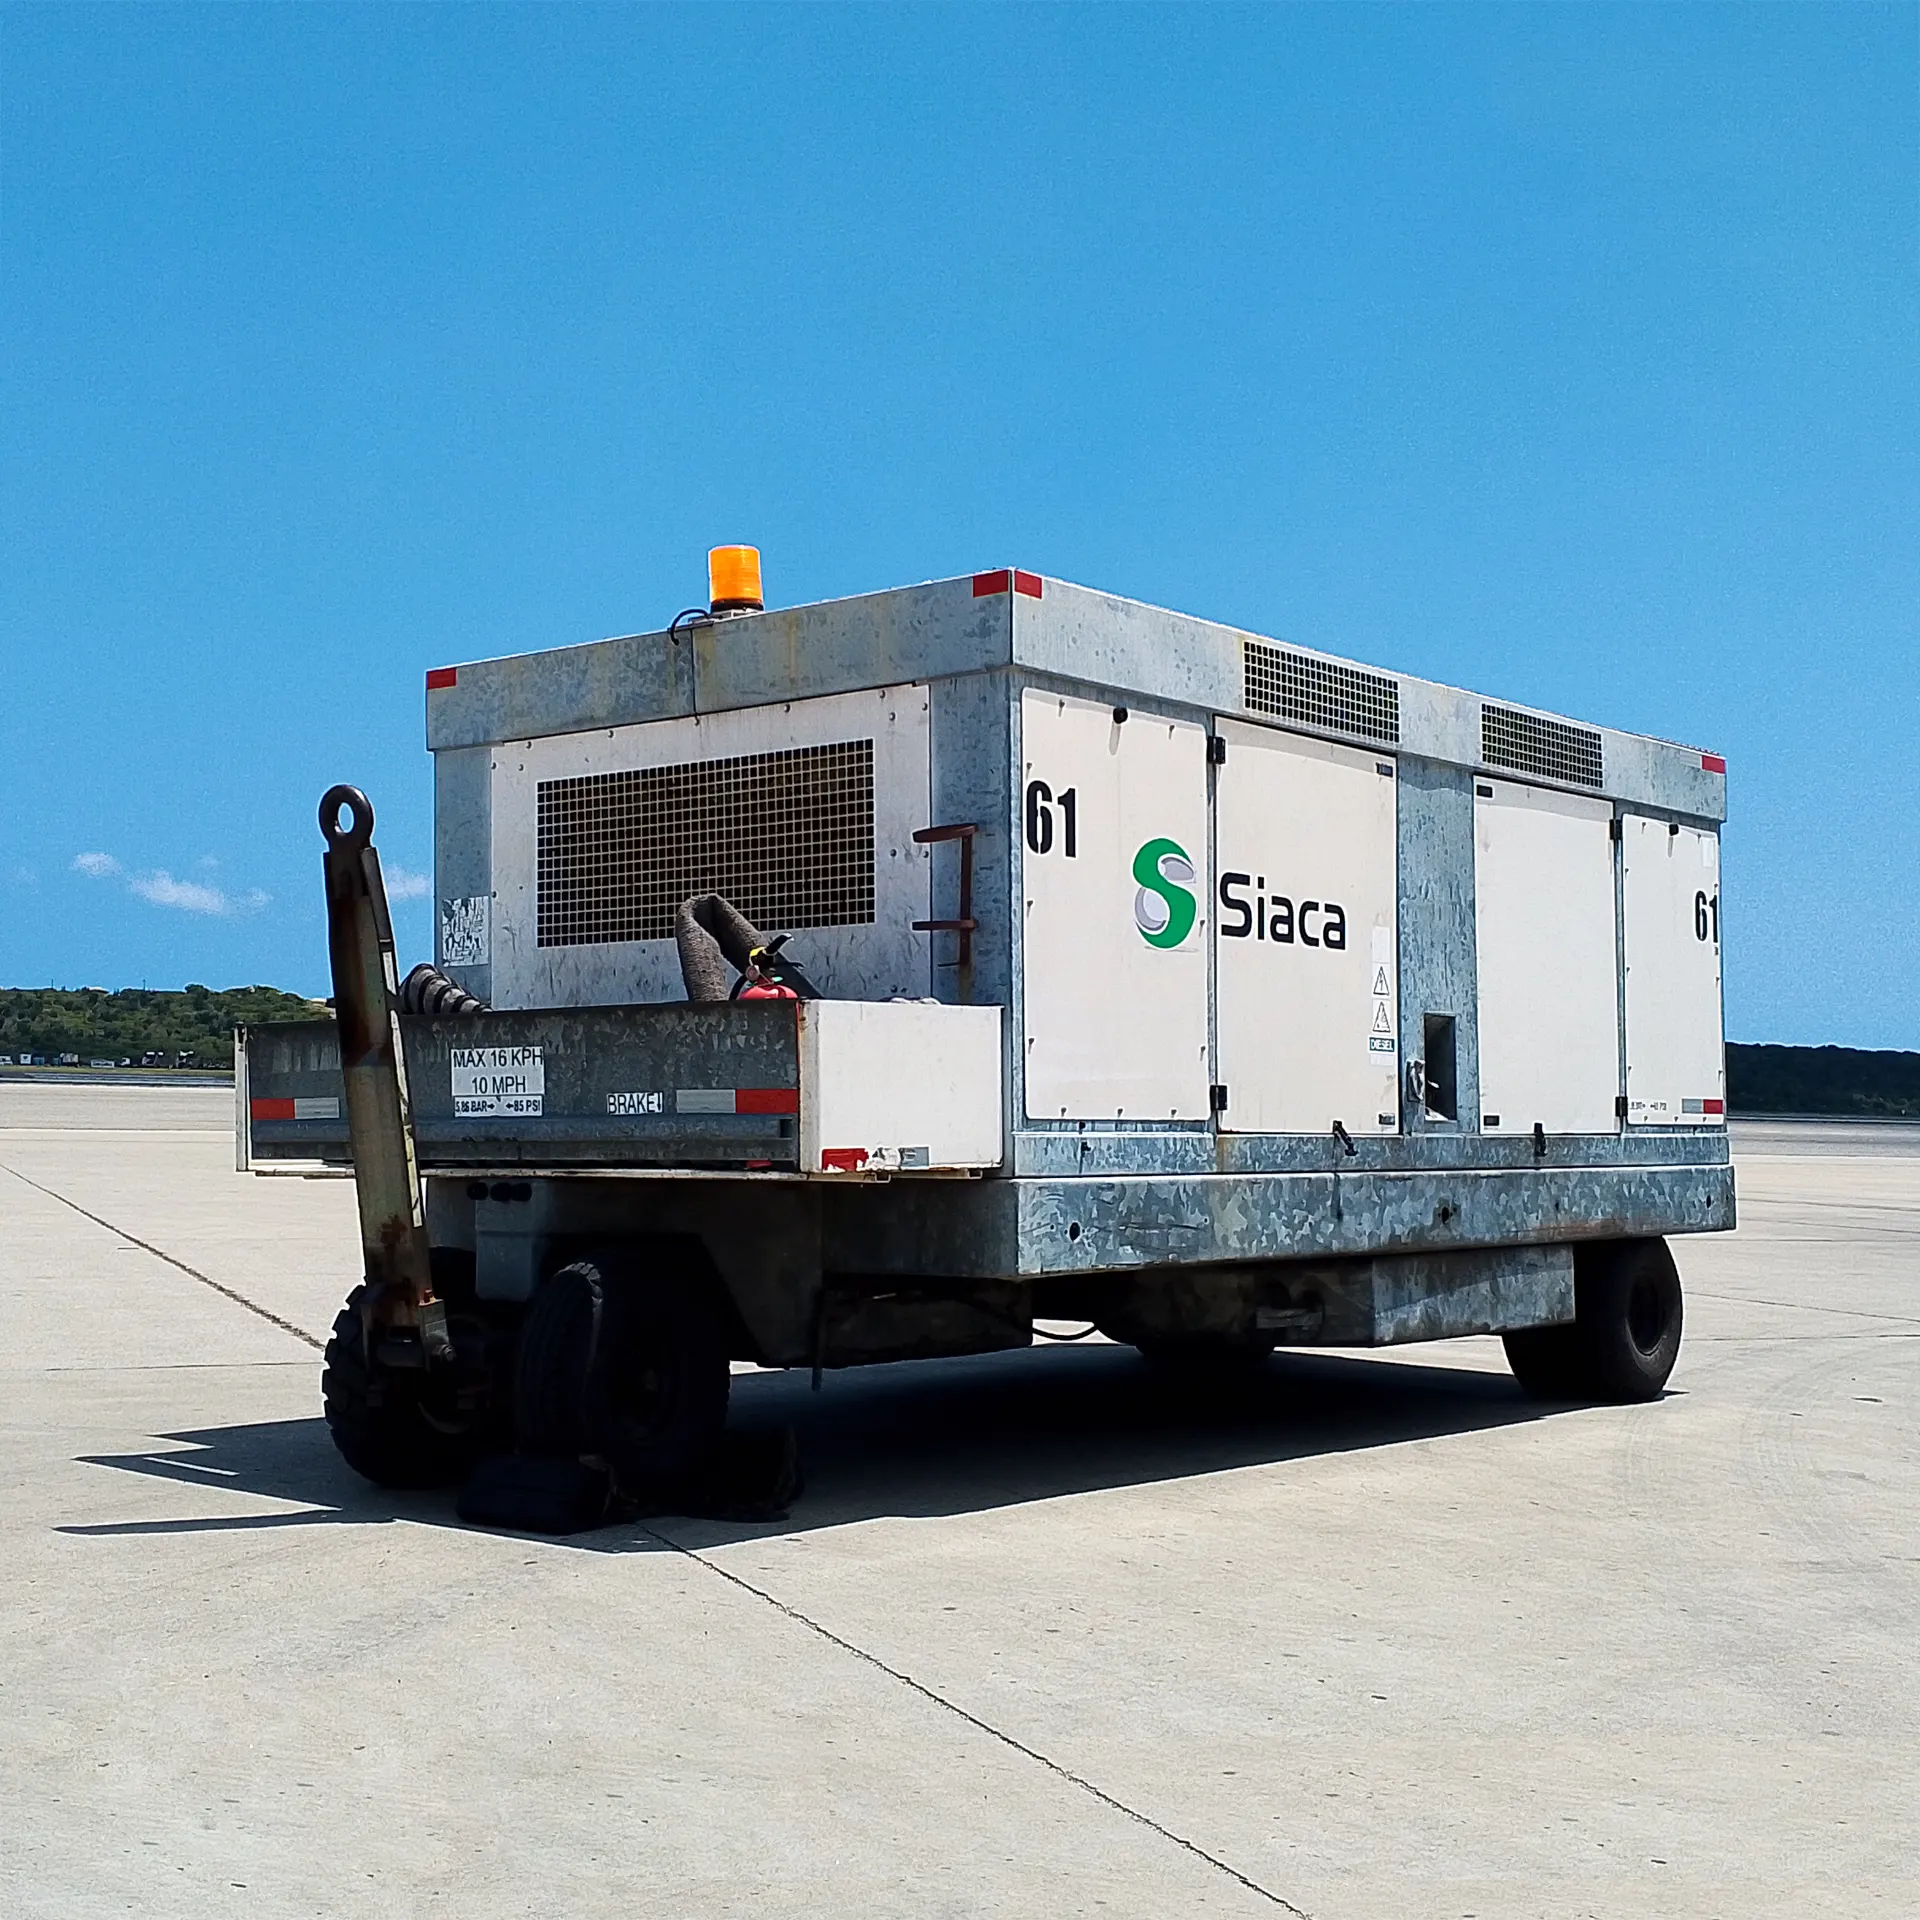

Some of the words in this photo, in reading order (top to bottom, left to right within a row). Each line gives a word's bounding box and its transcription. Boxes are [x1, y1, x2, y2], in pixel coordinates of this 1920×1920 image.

[1026, 780, 1076, 858] 61
[1220, 872, 1346, 950] Siaca
[1695, 890, 1718, 943] 61
[1370, 1038, 1394, 1051] DIESEL
[453, 1050, 486, 1068] MAX
[490, 1049, 508, 1067] 16
[511, 1048, 543, 1066] KPH
[472, 1077, 488, 1094] 10
[492, 1075, 526, 1094] MPH
[471, 1100, 487, 1113] BAR
[514, 1100, 525, 1112] 85
[526, 1099, 541, 1112] PSI
[608, 1092, 656, 1114] BRAKE
